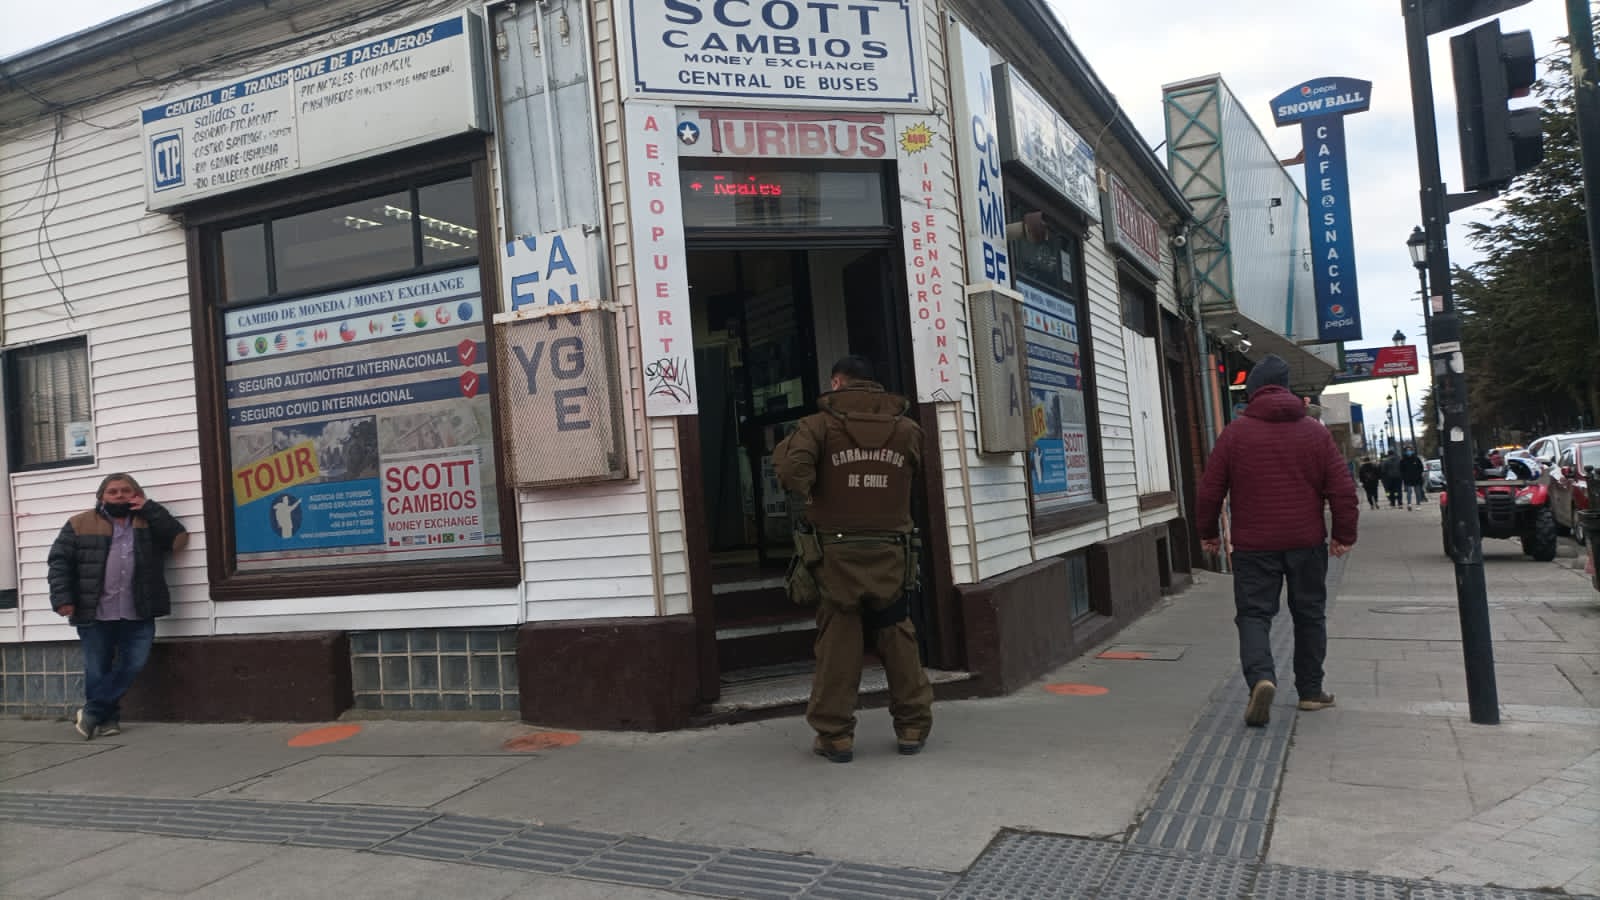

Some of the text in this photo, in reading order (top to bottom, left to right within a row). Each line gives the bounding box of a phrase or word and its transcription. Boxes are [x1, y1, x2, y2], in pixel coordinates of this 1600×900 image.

[664, 0, 880, 35] SCOTT
[662, 30, 889, 59] CAMBIOS
[165, 29, 434, 117] CENTRAL DE TRANSPORTE DE PASAJEROS
[684, 53, 875, 71] MONEY EXCHANGE
[678, 70, 879, 92] CENTRAL DE BUSES
[1312, 82, 1337, 96] pepsi
[194, 105, 236, 128] salidas
[1278, 92, 1364, 117] SNOW BALL
[698, 109, 886, 158] TURIBUS
[1316, 126, 1332, 191] CAFE
[972, 114, 1005, 364] CAMBIO
[1323, 212, 1342, 294] SNACK
[911, 220, 931, 321] SEGURO
[922, 161, 949, 383] INTERNACIONAL
[237, 309, 279, 328] CAMBIO
[281, 305, 297, 321] DE
[299, 298, 345, 317] MONEDA
[351, 289, 395, 309] MONEY
[398, 276, 465, 300] EXCHANGE
[238, 352, 451, 393] SEGURO AUTOMOTRIZ INTERNACIONAL
[240, 389, 413, 422] SEGURO COVID INTERNACIONAL
[237, 446, 315, 499] TOUR
[832, 448, 904, 468] CARABINEROS
[385, 459, 475, 493] SCOTT
[848, 474, 888, 488] DE CHILE
[386, 490, 477, 516] CAMBIOS
[388, 519, 422, 532] MONEY
[424, 515, 479, 529] EXCHANGE
